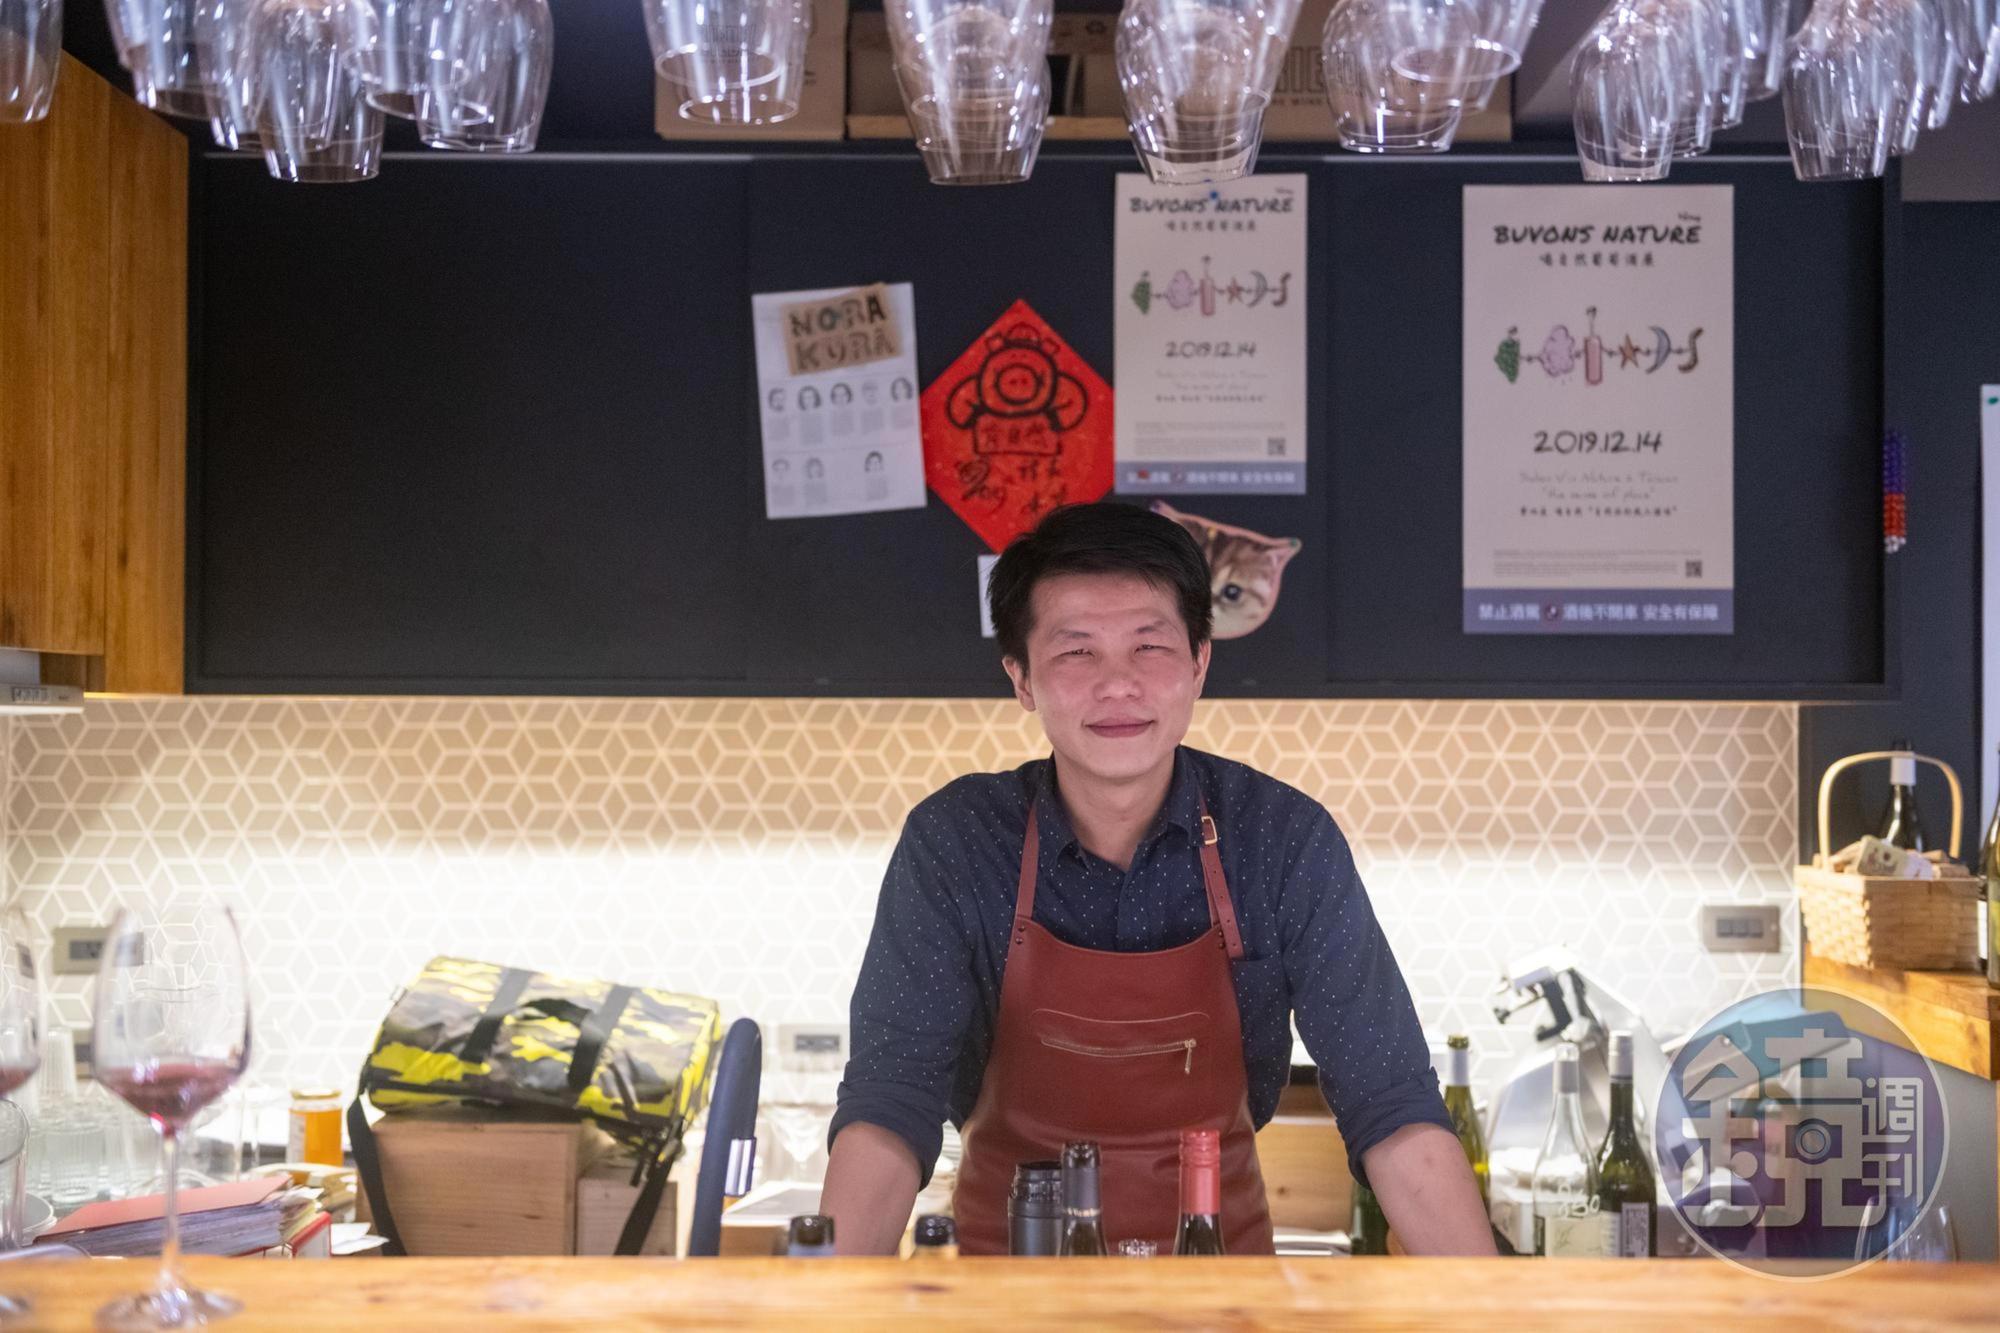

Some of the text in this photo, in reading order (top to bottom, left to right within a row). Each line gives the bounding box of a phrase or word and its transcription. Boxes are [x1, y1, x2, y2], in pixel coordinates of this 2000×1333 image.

[1130, 196, 1293, 213] BUVONS NATURE
[1493, 225, 1702, 244] BUVONS NATURE
[788, 293, 887, 337] NORA
[1534, 430, 1662, 454] 2019.12.14
